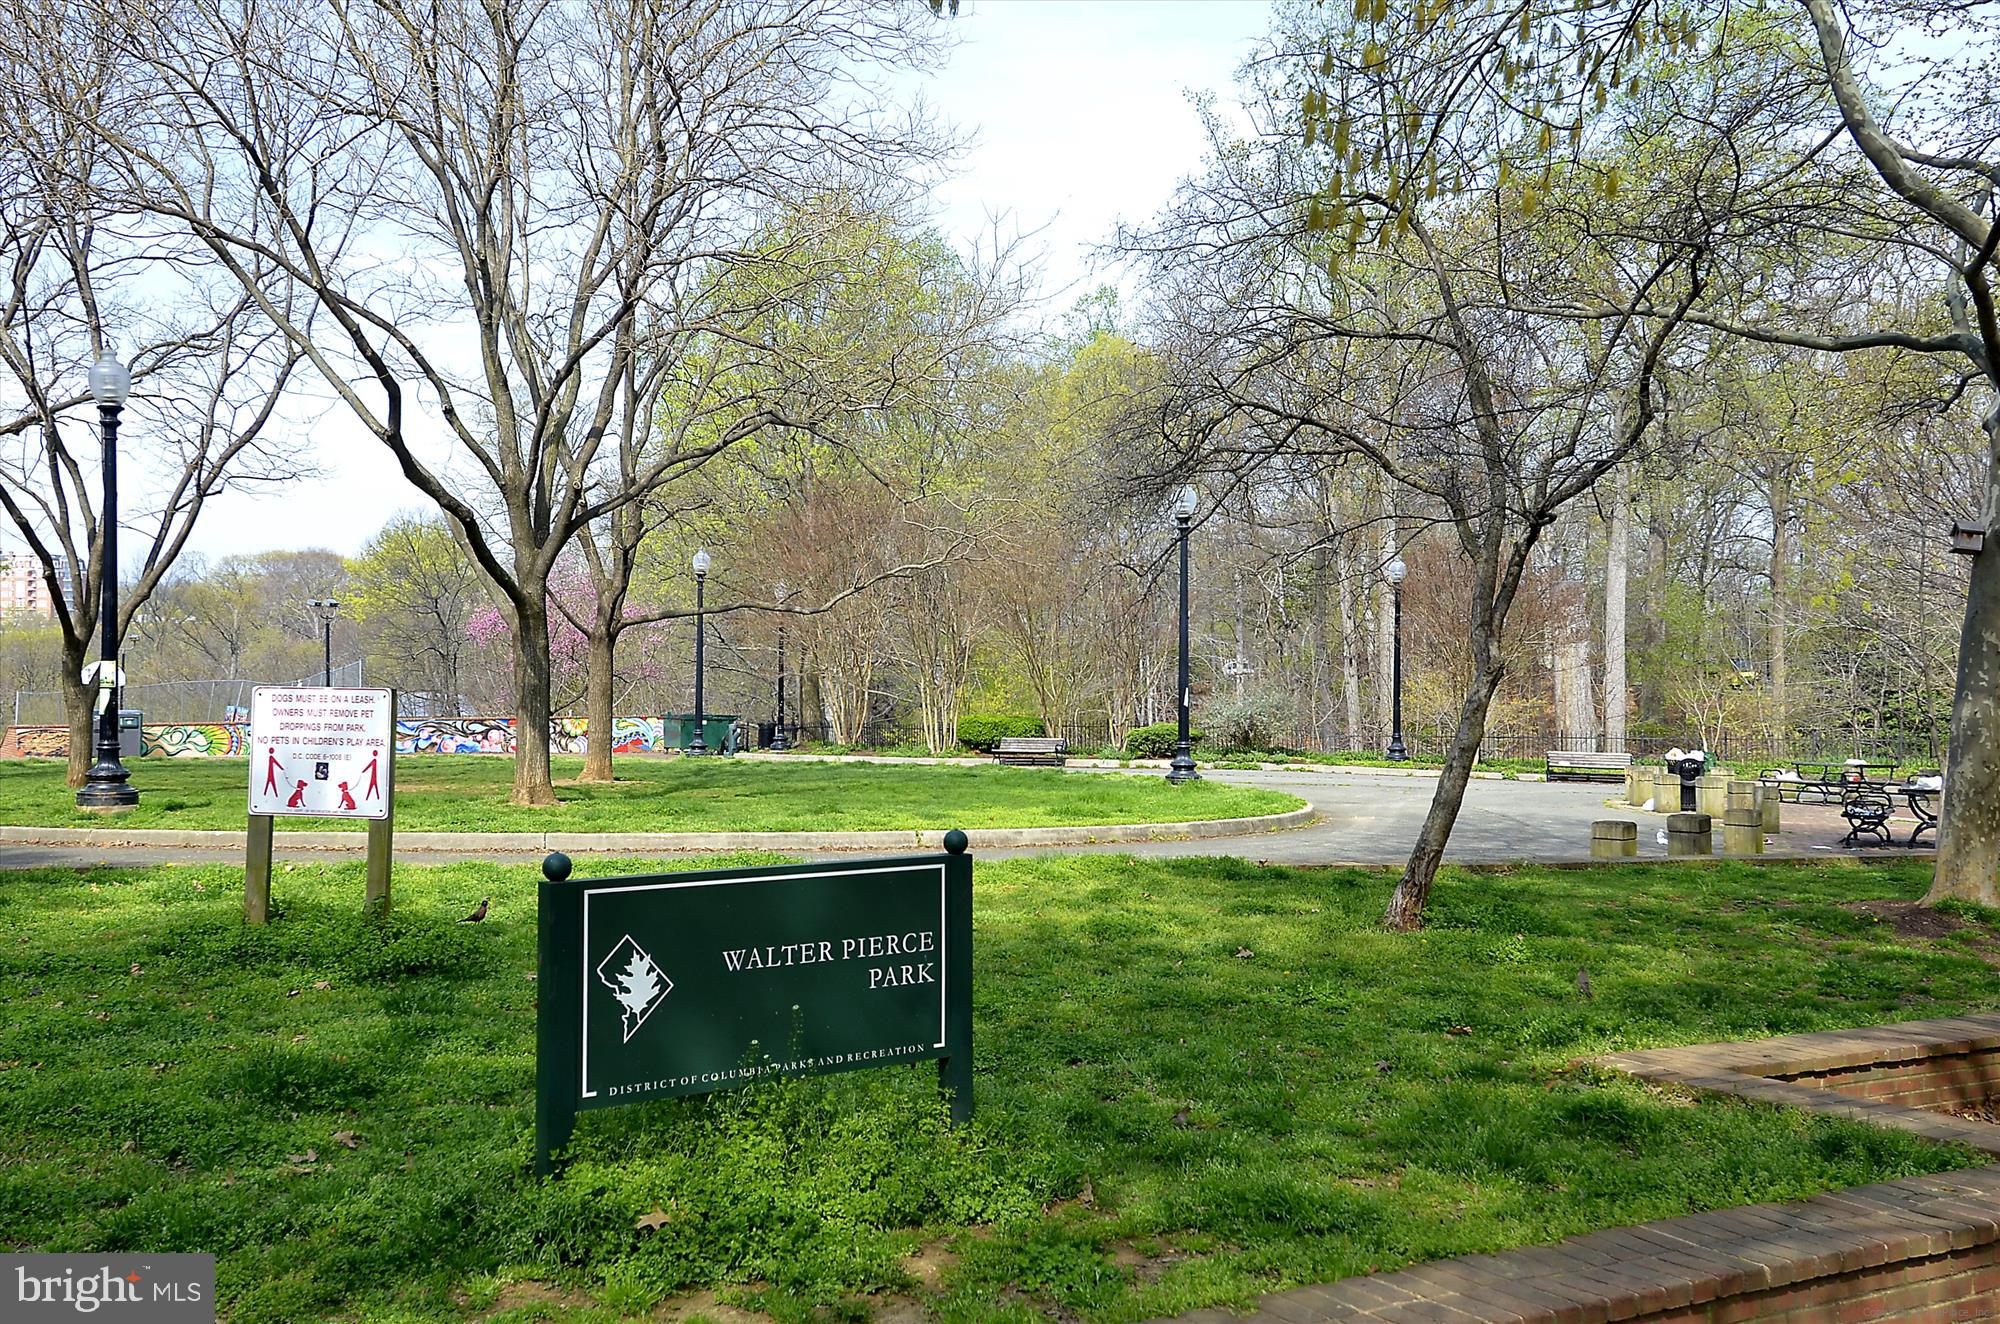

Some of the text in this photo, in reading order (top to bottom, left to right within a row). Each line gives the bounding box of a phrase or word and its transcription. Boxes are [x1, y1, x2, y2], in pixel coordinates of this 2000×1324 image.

[272, 694, 293, 703] DOGS
[296, 694, 316, 703] MUST
[319, 695, 328, 703] BE
[332, 695, 342, 703] ON
[343, 695, 349, 703] A
[272, 708, 374, 718] OWNERS MUST REMOVE PET
[279, 722, 321, 731] DROPPINGS
[324, 723, 344, 732] FROM
[257, 736, 268, 744] NO
[271, 736, 290, 745] PETS
[292, 737, 300, 745] IN
[302, 737, 344, 746] CHILDREN'S
[346, 738, 363, 747] PLAY
[722, 931, 935, 972] WALTER PIERCE
[868, 962, 935, 989] PARK
[608, 1043, 925, 1097] DISTRICT OF COLUMBIA PARKS AND RECREATION
